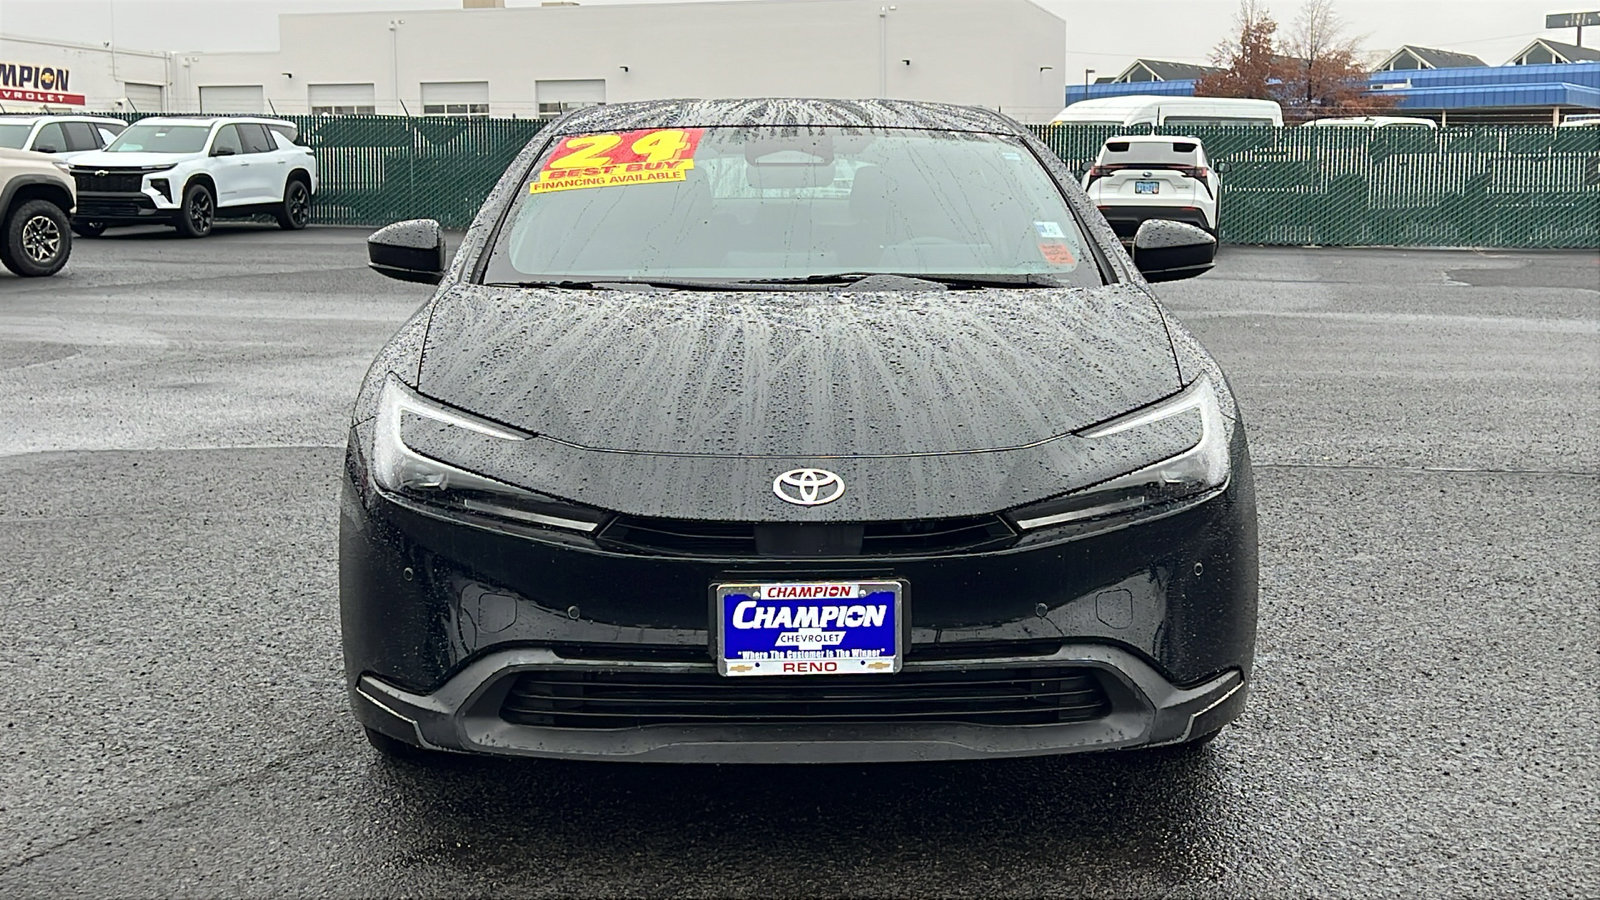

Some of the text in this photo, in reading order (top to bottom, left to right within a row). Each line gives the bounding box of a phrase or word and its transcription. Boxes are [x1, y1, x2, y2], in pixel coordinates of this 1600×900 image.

[550, 130, 690, 168] 24
[548, 161, 681, 179] BEST BUY
[533, 172, 681, 191] FINANCING AVAILABLE
[767, 586, 852, 598] CHAMPION
[733, 601, 887, 629] CHAMPION
[780, 633, 840, 643] CHEVROLET
[783, 662, 837, 673] RENO
